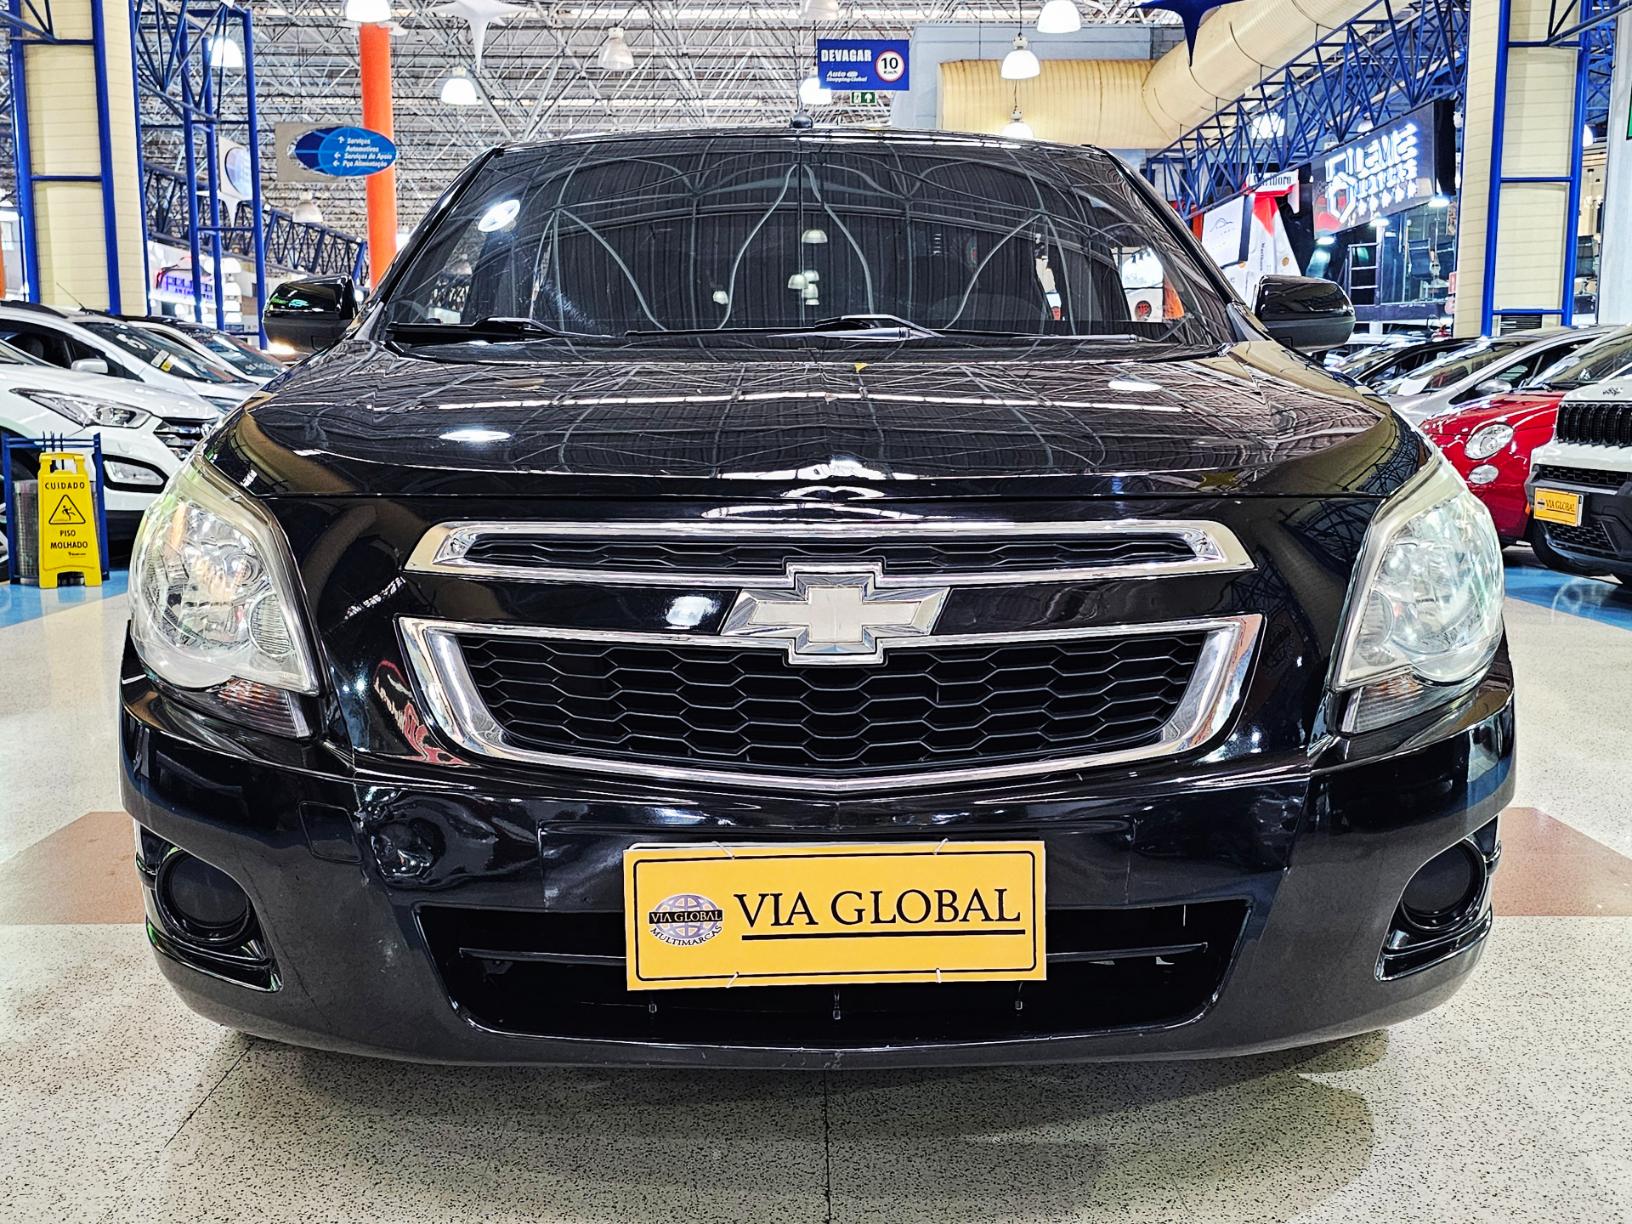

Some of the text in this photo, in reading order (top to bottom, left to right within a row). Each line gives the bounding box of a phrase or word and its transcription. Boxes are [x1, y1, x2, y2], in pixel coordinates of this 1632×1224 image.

[820, 49, 872, 62] DEVAGAR
[881, 57, 898, 70] 10
[44, 481, 85, 490] CUIDADO
[59, 529, 76, 537] PISO
[50, 541, 88, 549] MOLHADO
[732, 888, 1021, 928] VIA GLOBAL
[651, 911, 722, 923] VIA GLOBAL
[650, 925, 723, 946] MULTIMARCAS
